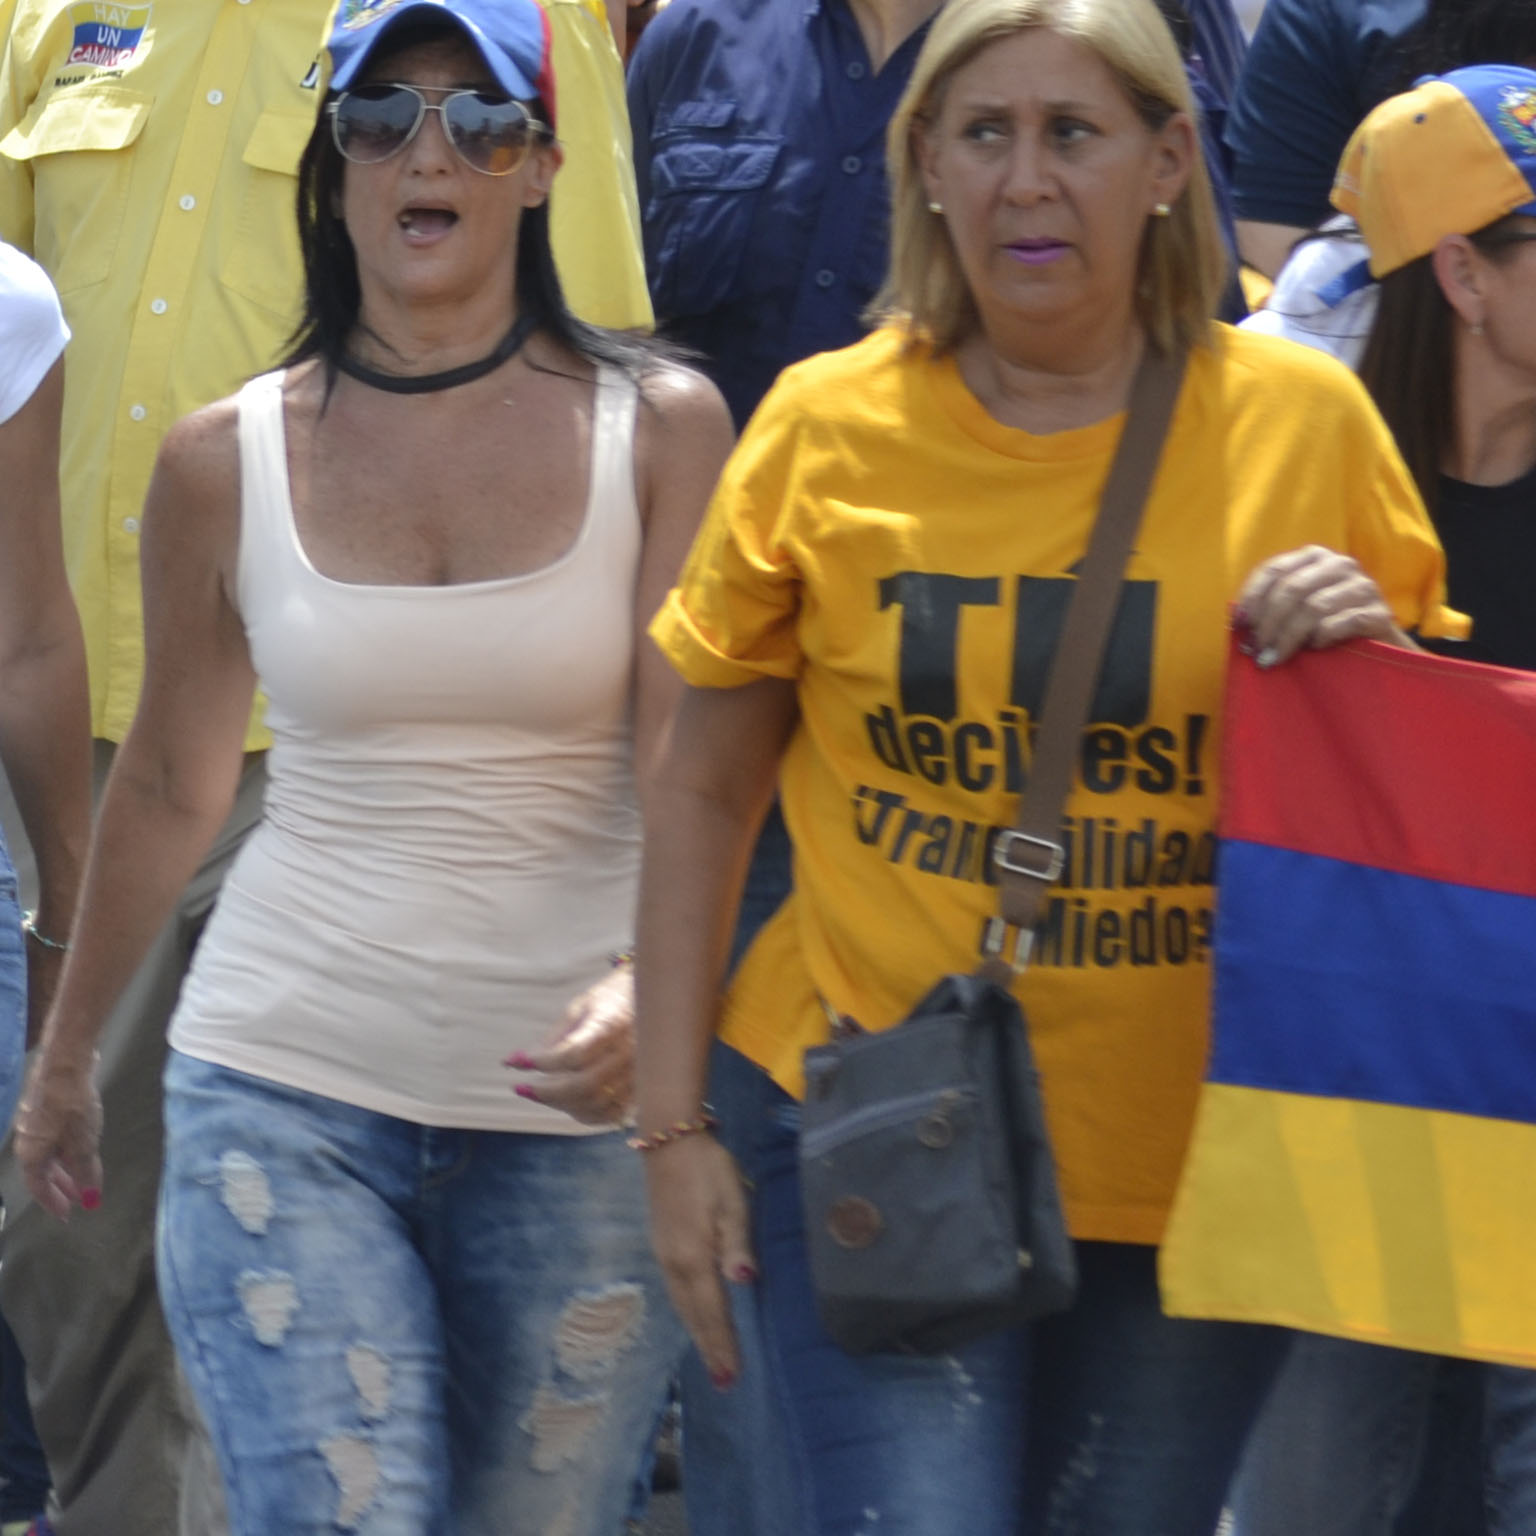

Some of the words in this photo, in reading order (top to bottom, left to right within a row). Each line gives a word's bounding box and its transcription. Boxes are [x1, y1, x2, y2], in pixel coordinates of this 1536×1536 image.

[93, 3, 131, 29] HAY
[97, 26, 122, 47] UN
[69, 44, 133, 67] CAMINO
[865, 703, 1211, 796] decies!
